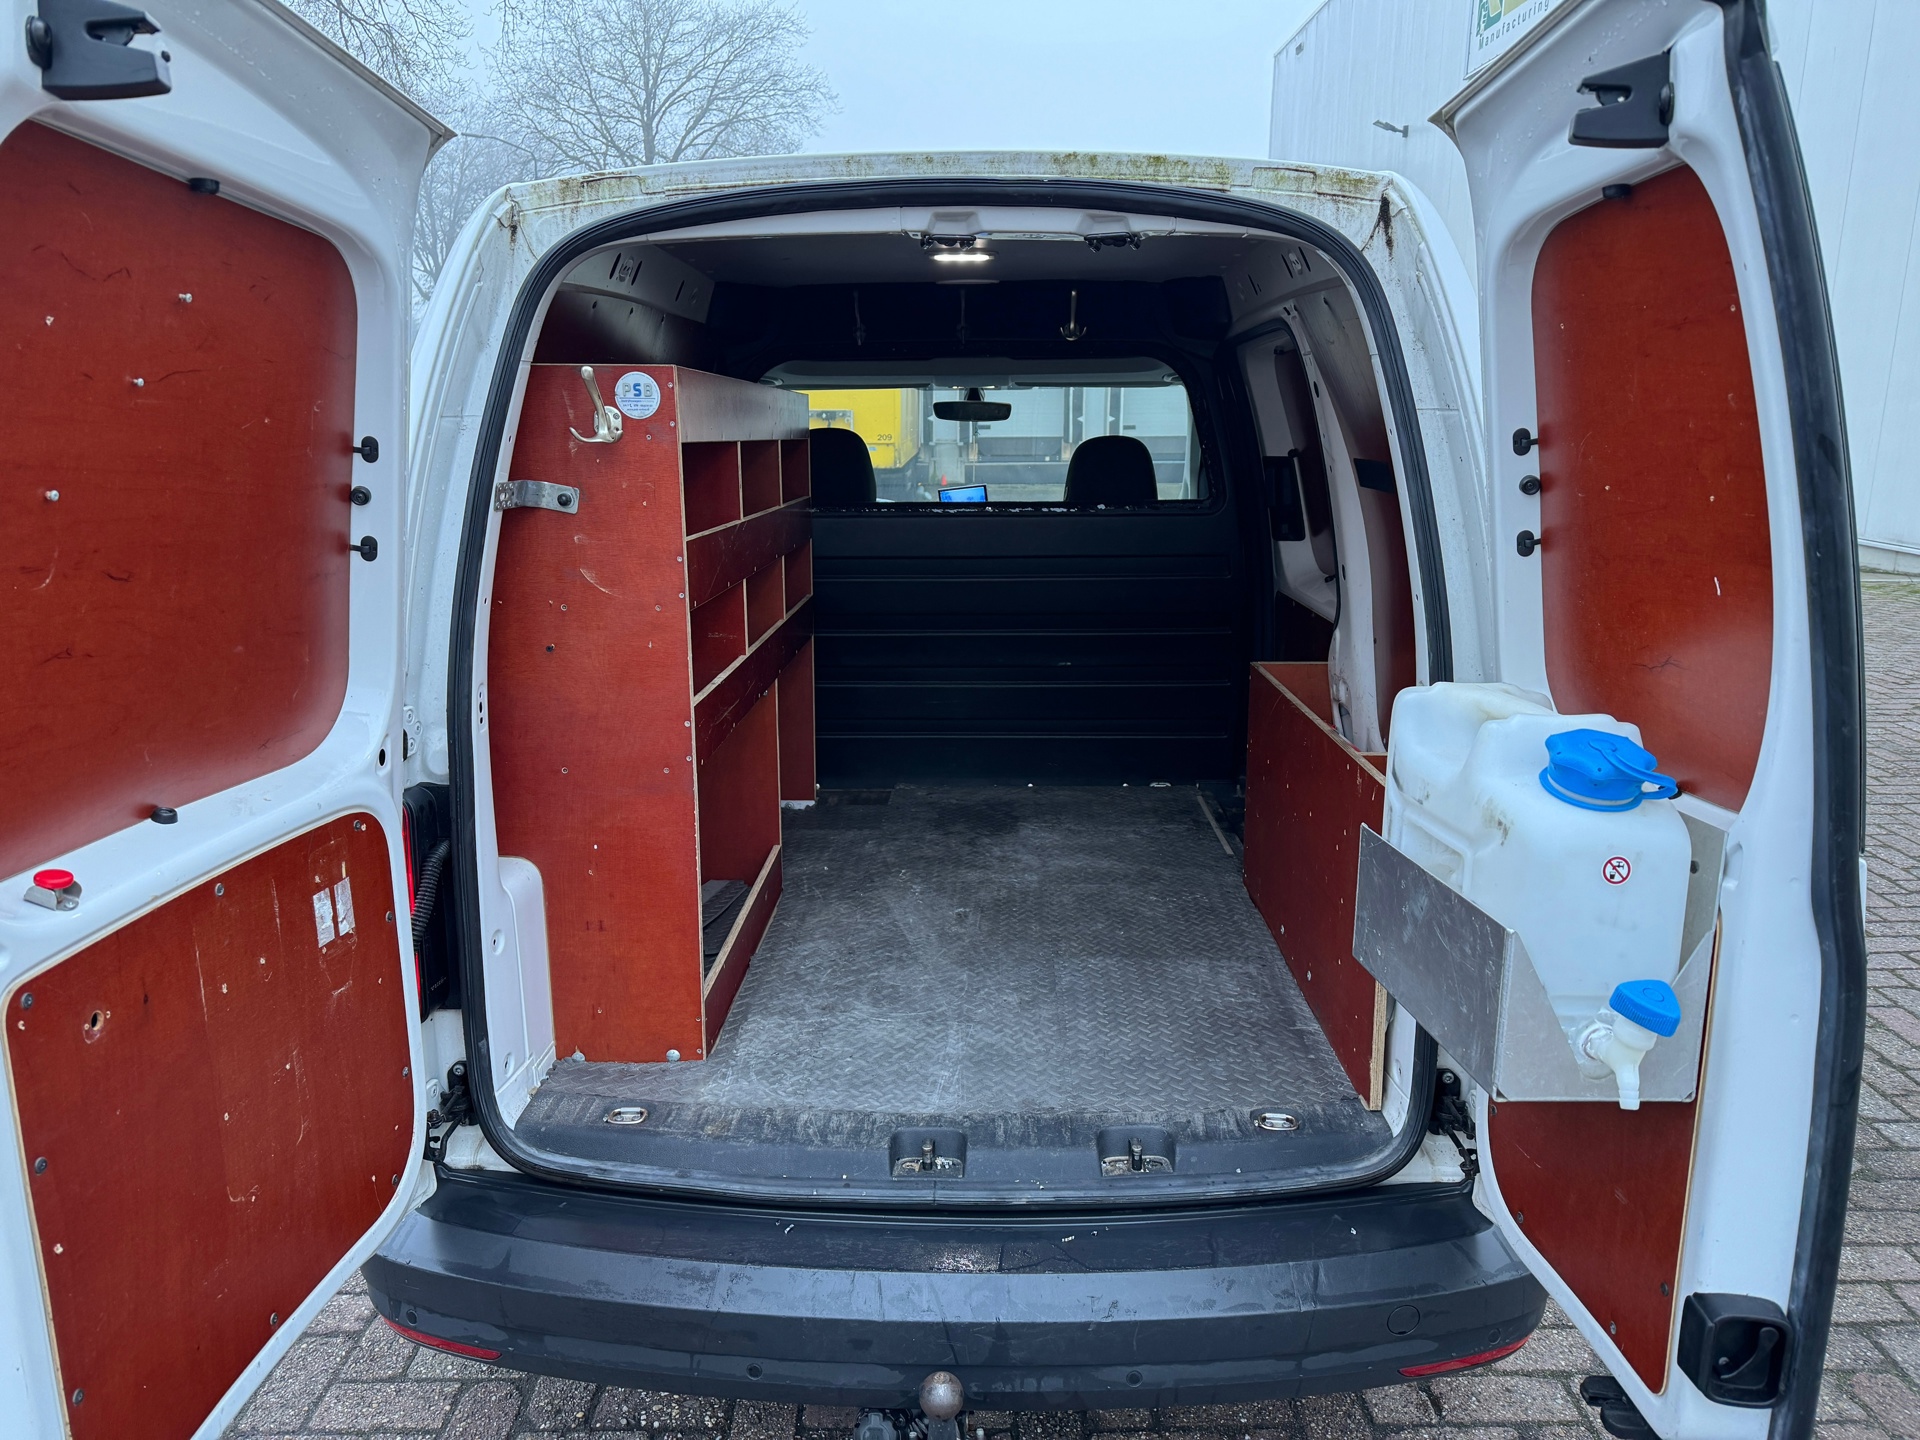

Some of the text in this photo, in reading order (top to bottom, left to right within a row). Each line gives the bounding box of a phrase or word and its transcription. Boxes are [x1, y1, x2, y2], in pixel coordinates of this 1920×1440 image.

[1478, 0, 1550, 51] Manufacturing
[622, 382, 653, 398] PSB
[877, 433, 893, 441] 209
